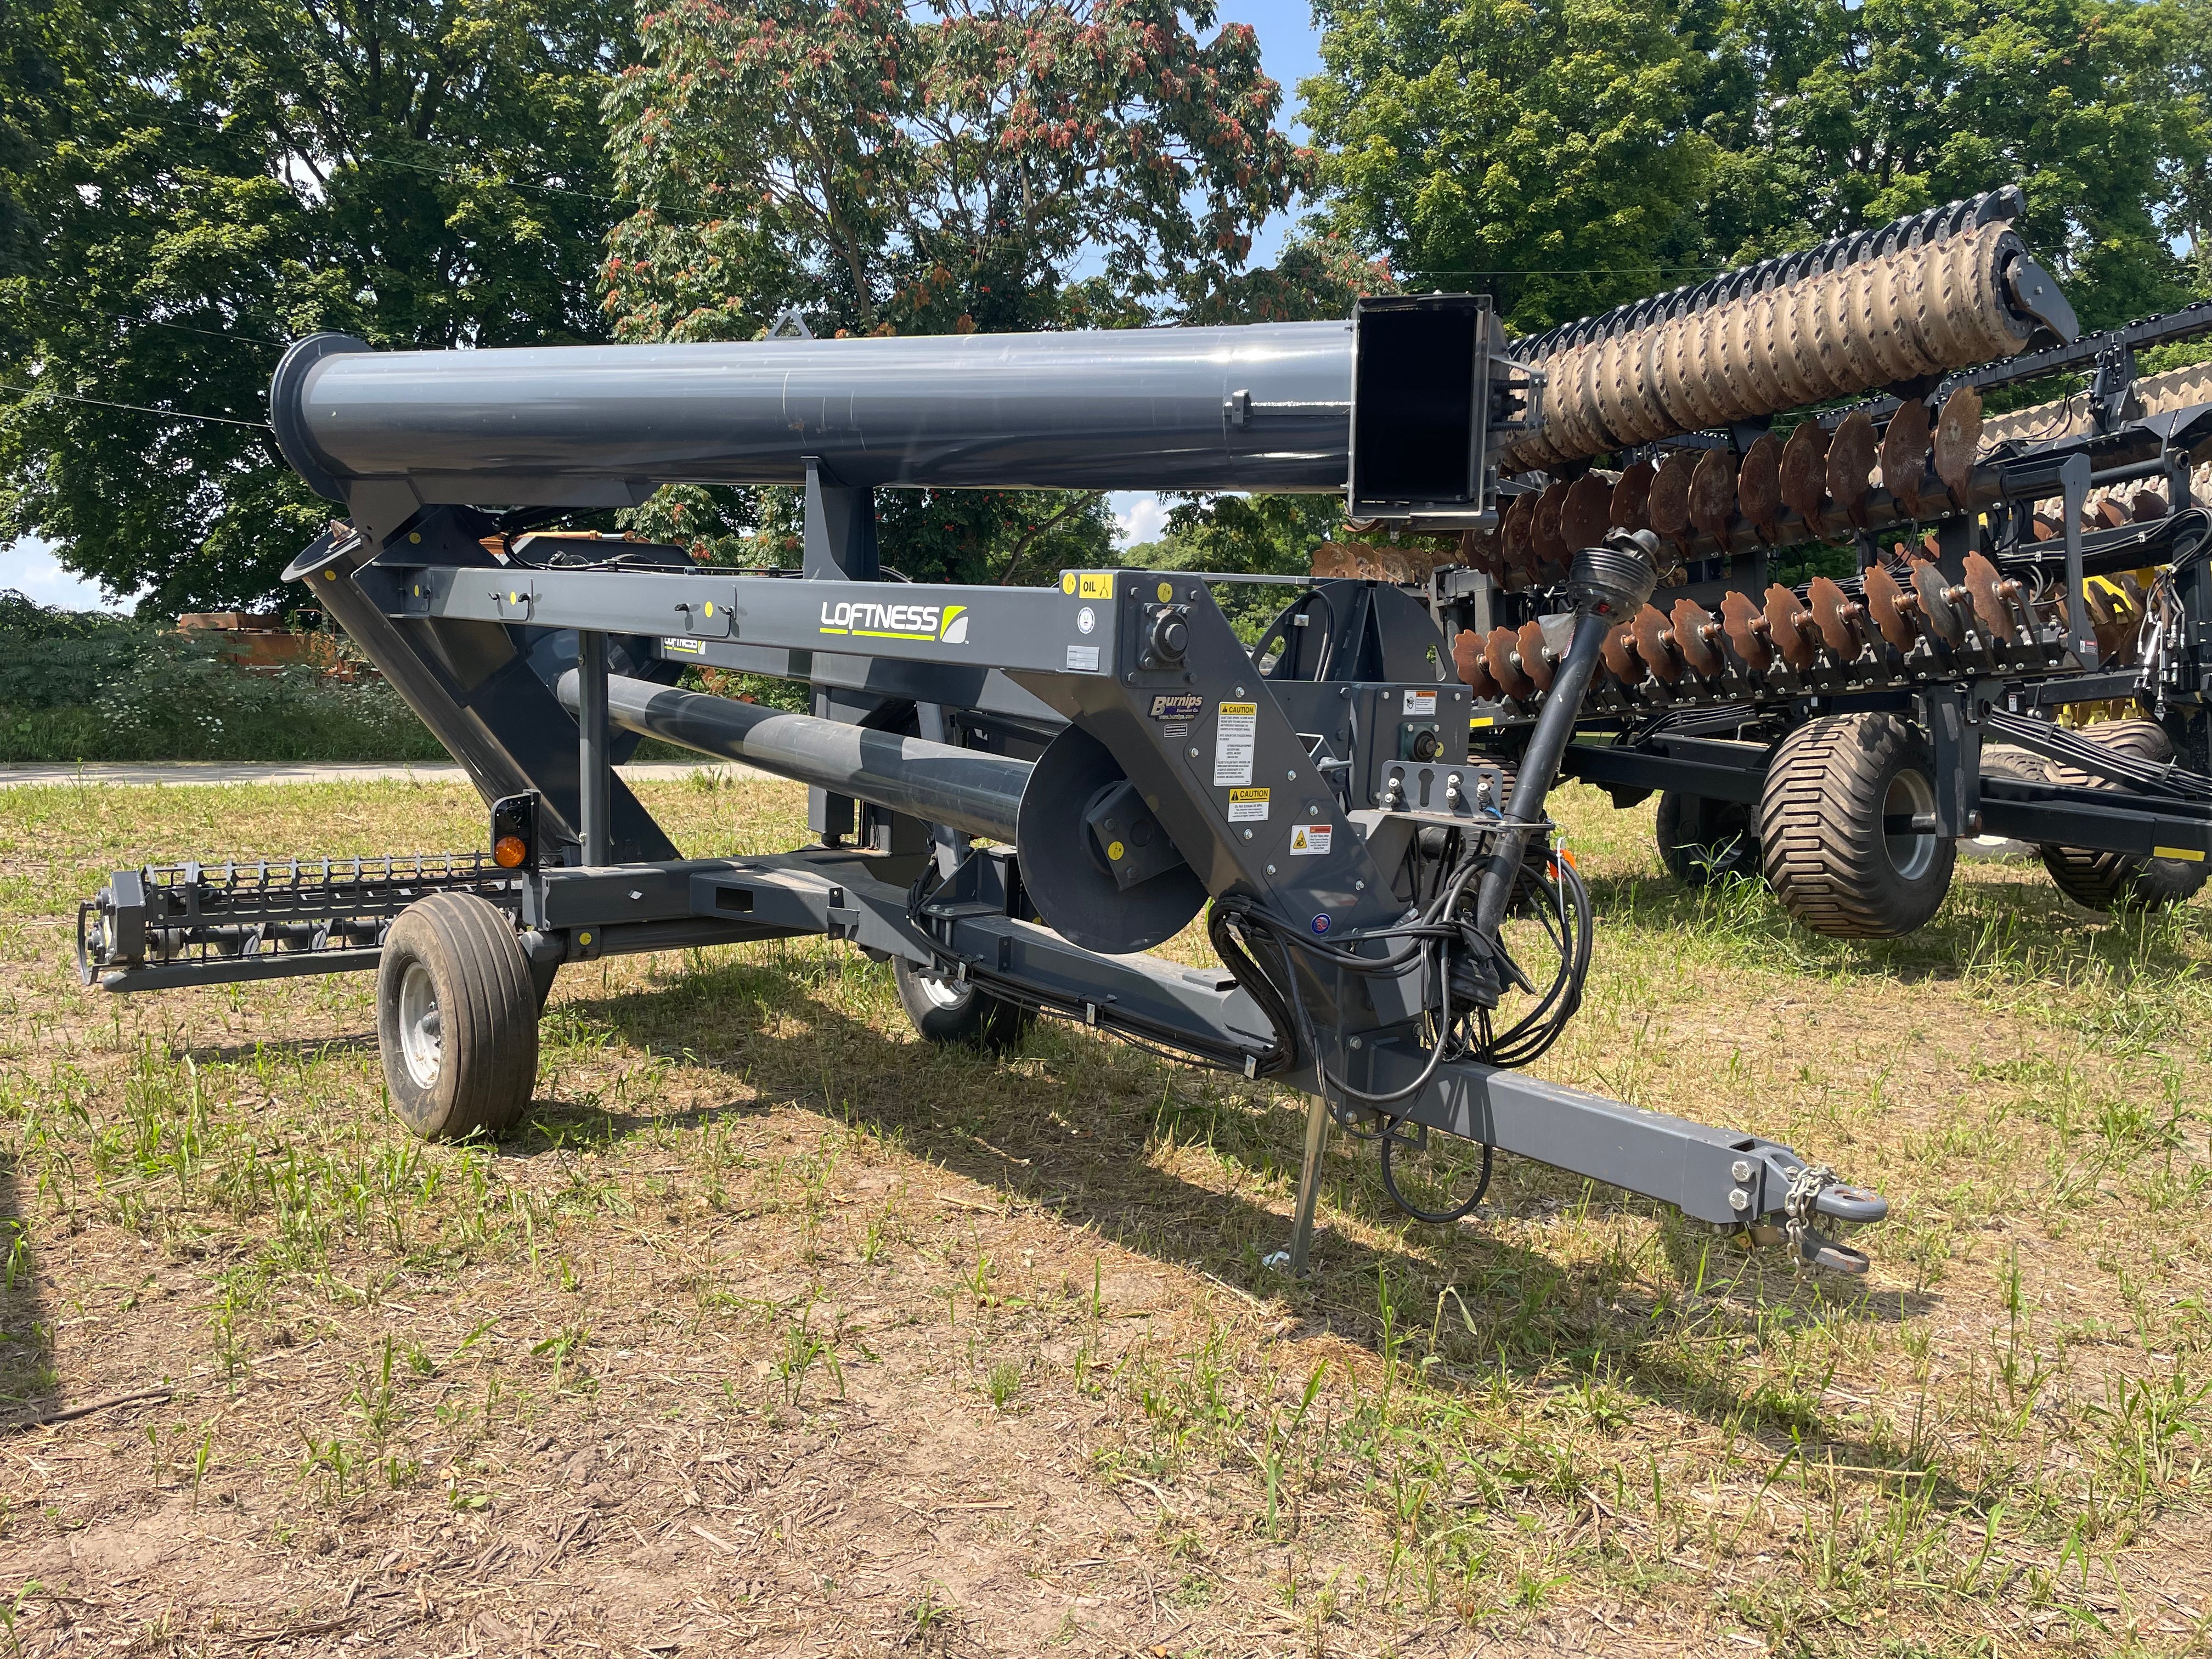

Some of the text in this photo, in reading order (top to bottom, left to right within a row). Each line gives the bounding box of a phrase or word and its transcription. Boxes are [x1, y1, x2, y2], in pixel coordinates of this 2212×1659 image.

[1083, 581, 1096, 592] OIL
[821, 601, 940, 631] LOFTNESS
[1150, 693, 1203, 716] Burnips
